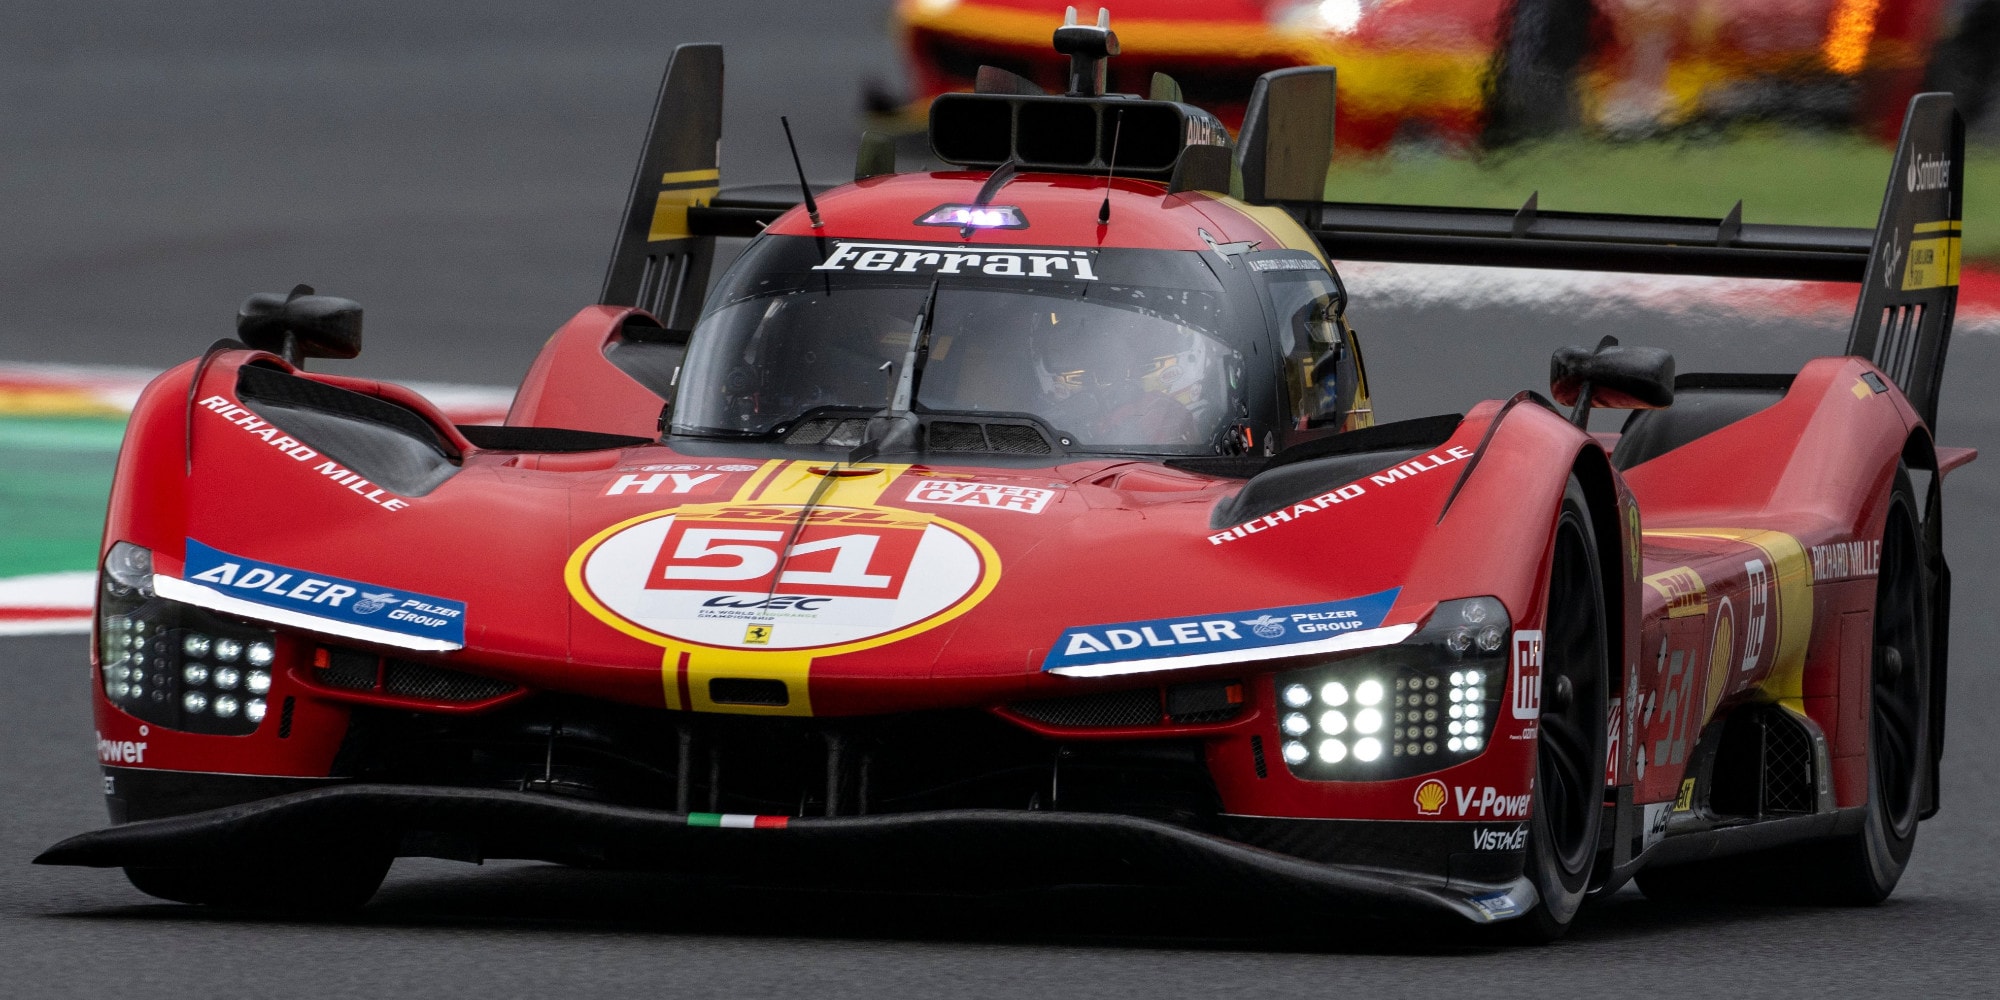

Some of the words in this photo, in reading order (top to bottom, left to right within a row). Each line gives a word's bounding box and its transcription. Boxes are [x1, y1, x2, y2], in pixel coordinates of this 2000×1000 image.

[1916, 152, 1950, 191] Santander
[811, 243, 1098, 280] Ferrari
[198, 395, 318, 462] RICHARD
[313, 461, 410, 512] MILLE
[605, 474, 723, 496] HY
[917, 489, 1037, 511] CAR
[924, 481, 1044, 498] HYPER
[1207, 484, 1366, 545] RICHARD
[1370, 446, 1474, 487] MILLE
[712, 508, 896, 525] DHL
[664, 528, 892, 589] 51
[1812, 543, 1848, 580] RICHARD
[1849, 540, 1880, 577] MILLE
[191, 562, 357, 608] ADLER
[702, 595, 833, 611] WEC
[1063, 620, 1243, 656] ADLER
[1654, 649, 1696, 767] 51
[1454, 786, 1531, 817] V-Power
